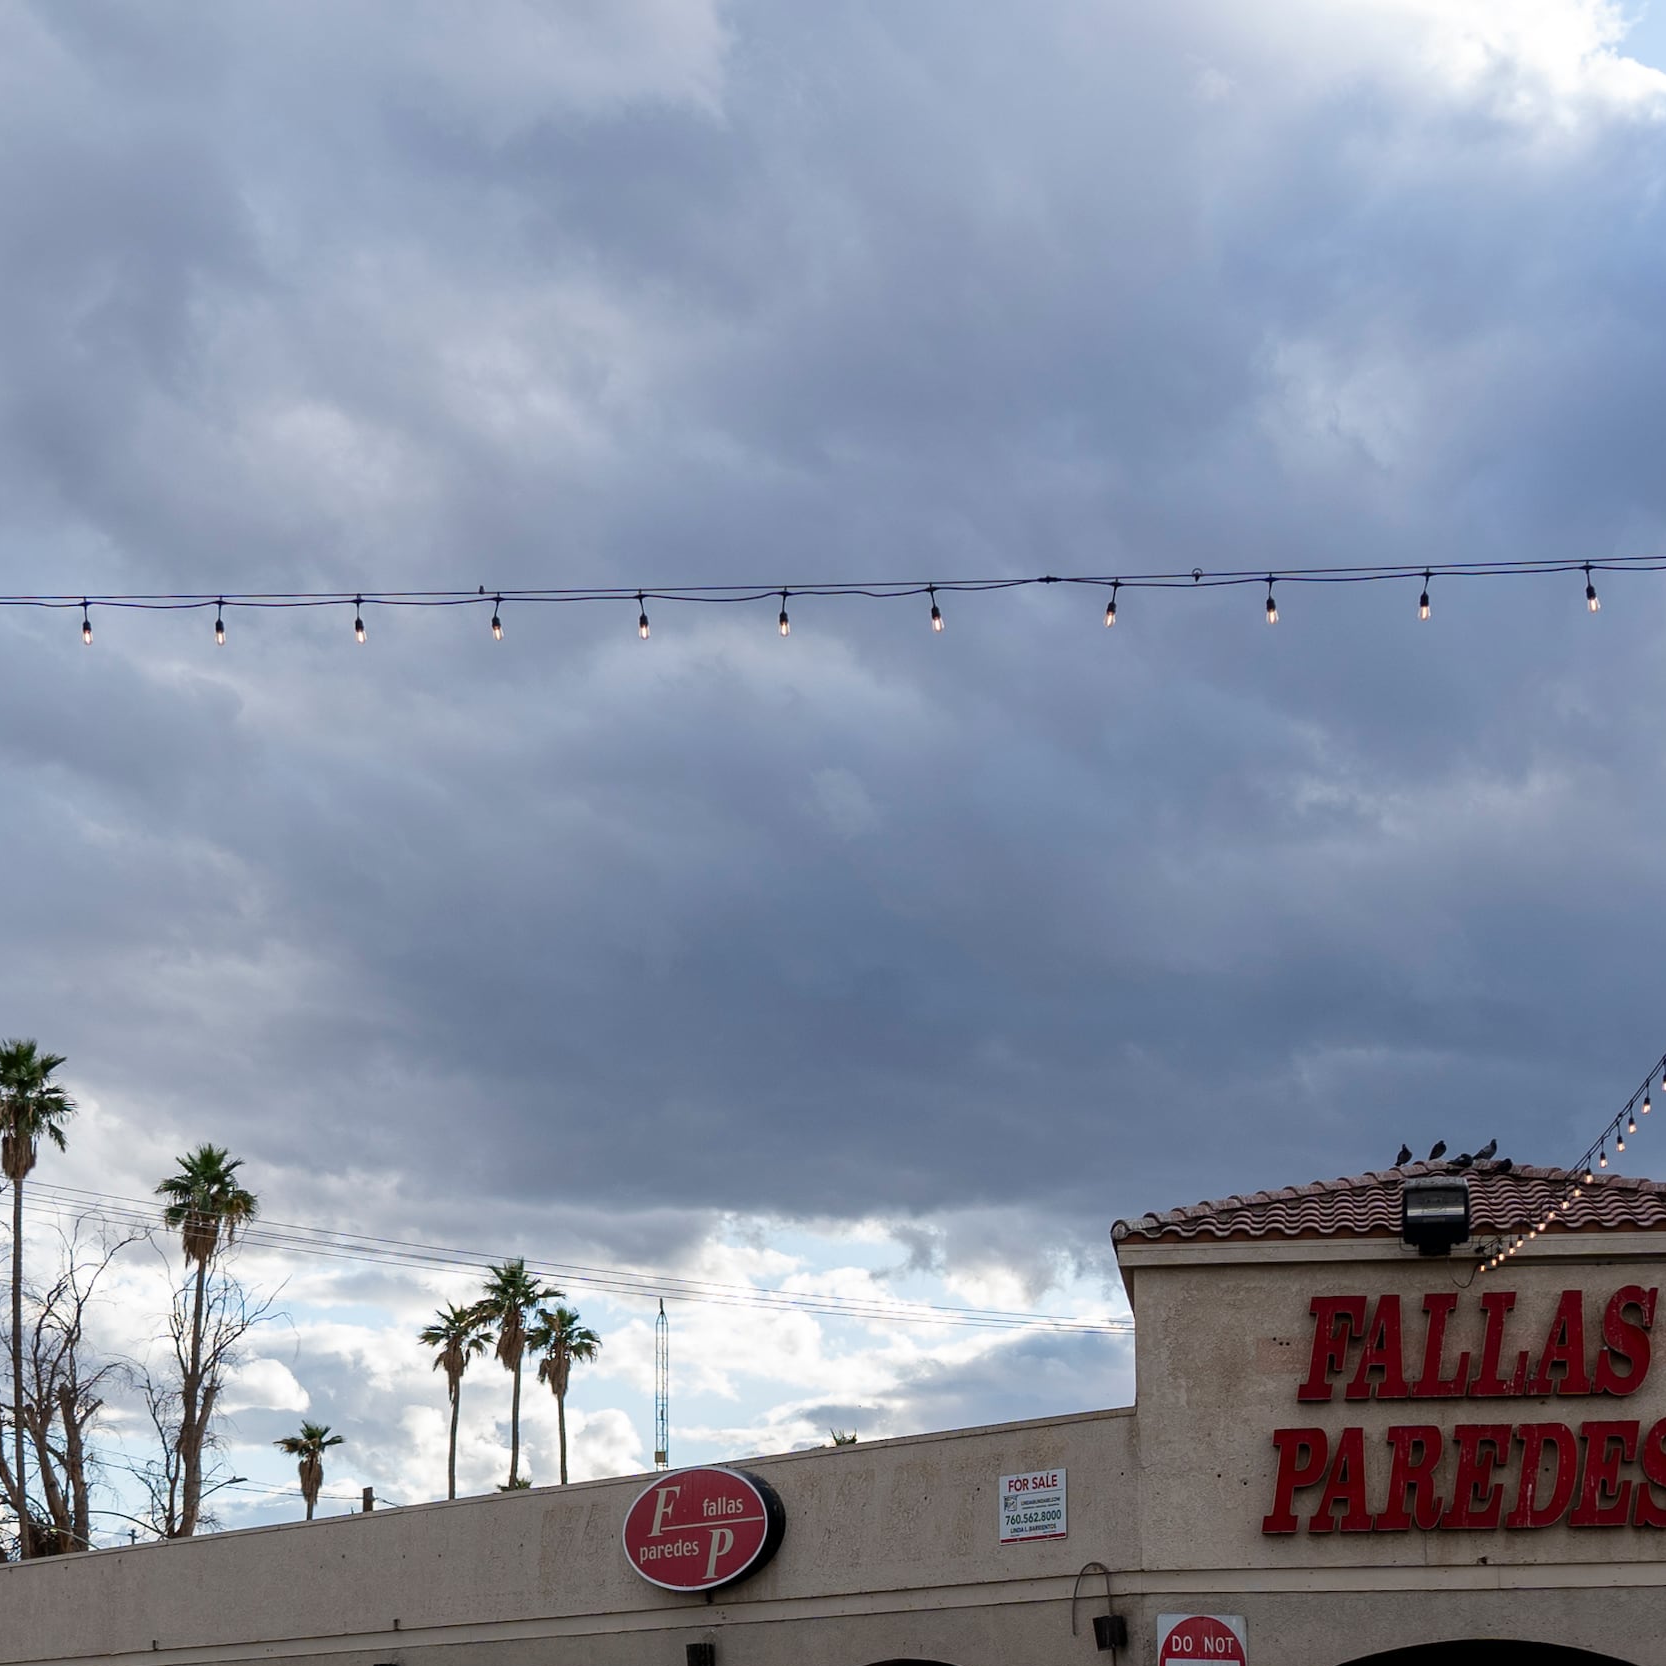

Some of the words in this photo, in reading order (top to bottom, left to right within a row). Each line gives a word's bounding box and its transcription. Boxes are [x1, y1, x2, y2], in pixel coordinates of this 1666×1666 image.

[1297, 1285, 1659, 1400] FALLAS
[1008, 1478, 1029, 1493] FOR
[1032, 1474, 1058, 1490] SALE
[647, 1486, 681, 1537] F
[702, 1496, 744, 1517] fallas
[1005, 1509, 1062, 1526] 760.562.8000
[639, 1539, 700, 1564] paredes
[702, 1528, 735, 1579] P
[1172, 1635, 1193, 1652] DO
[1204, 1636, 1235, 1654] NOT
